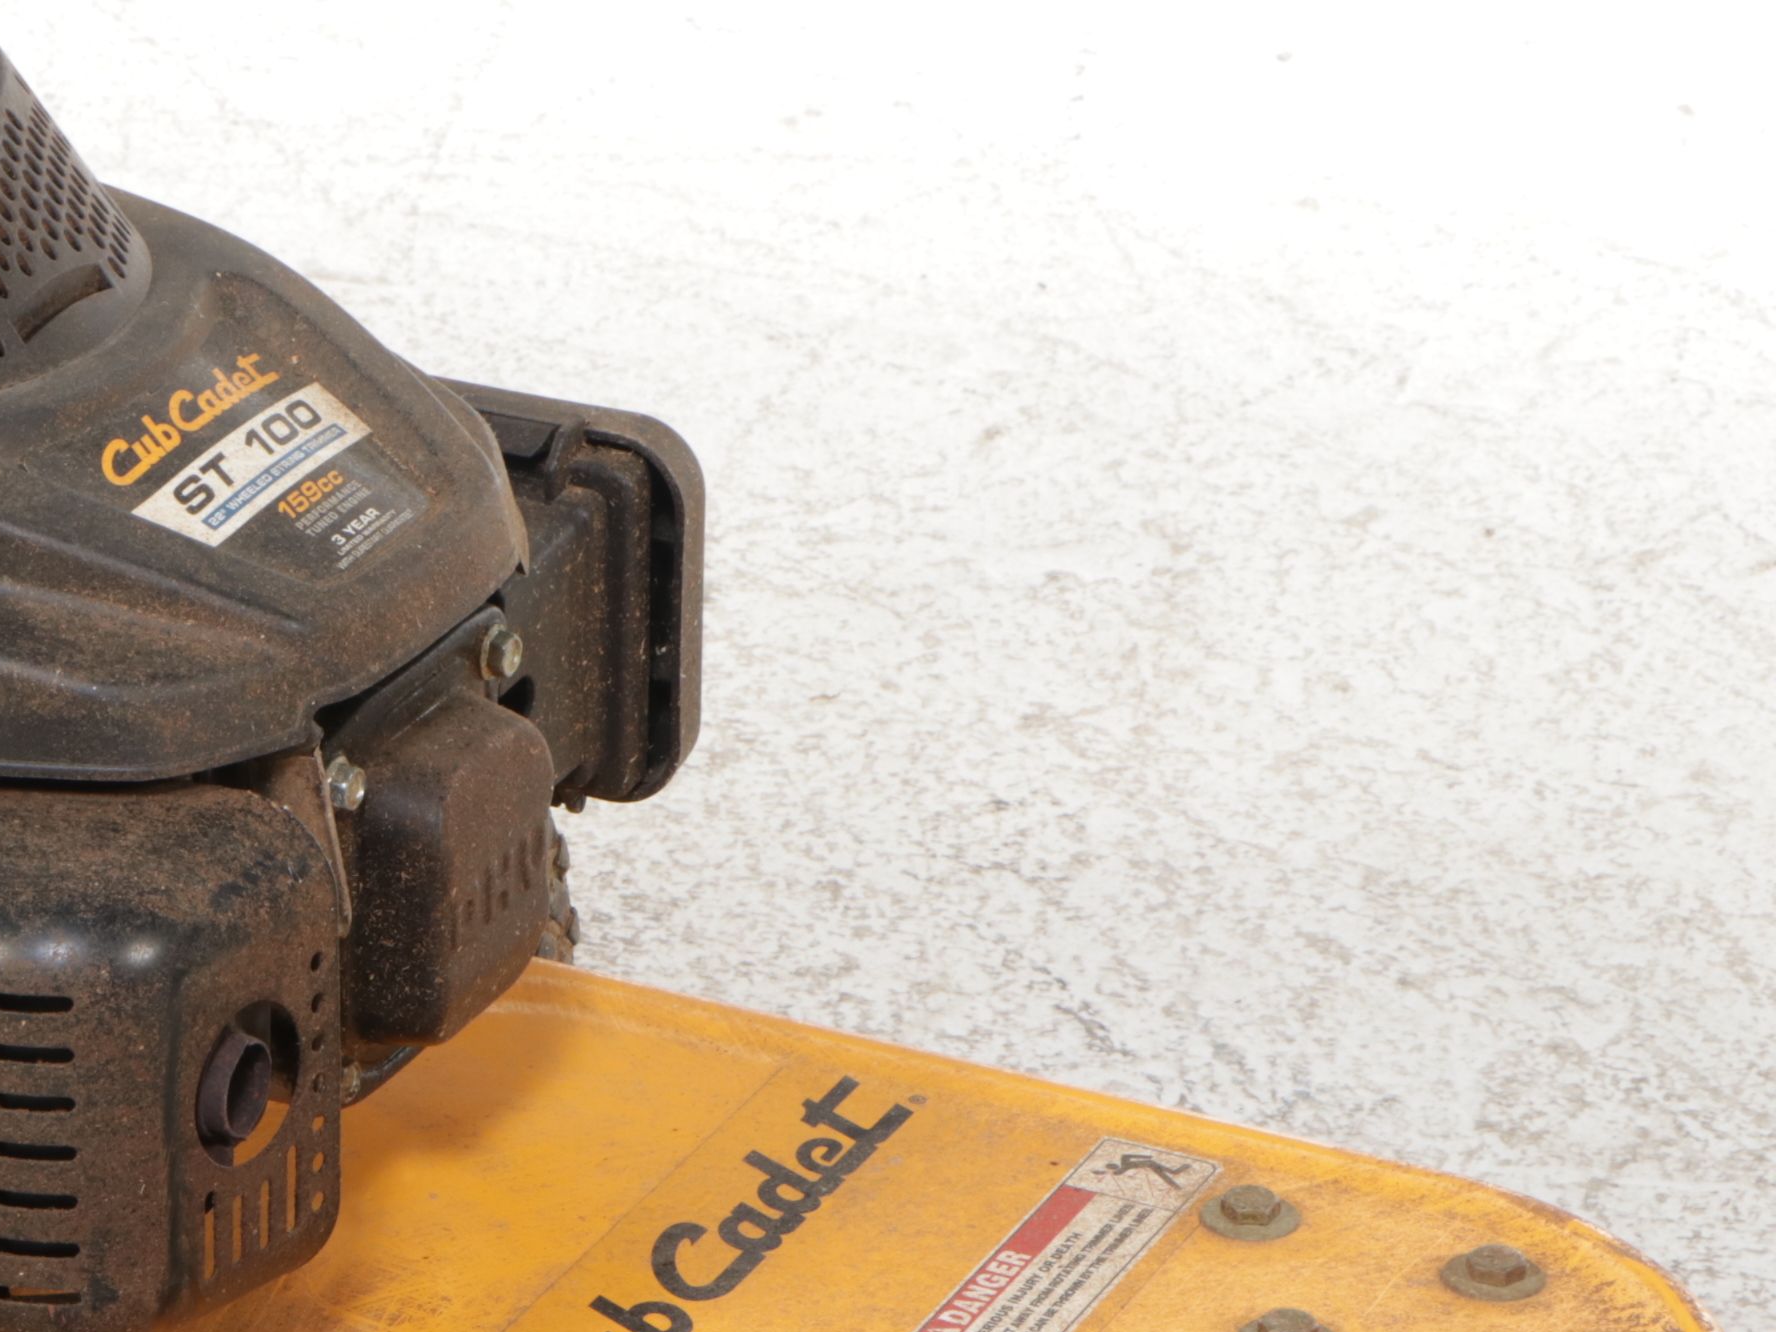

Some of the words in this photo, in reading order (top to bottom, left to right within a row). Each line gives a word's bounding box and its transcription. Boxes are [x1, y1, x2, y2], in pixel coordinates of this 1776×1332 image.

[101, 414, 182, 486] Cub
[168, 352, 281, 432] Cadet
[173, 452, 231, 515] ST
[244, 399, 322, 455] 100
[228, 473, 272, 513] WHEELED
[271, 451, 305, 479] STRING
[302, 425, 342, 457] TRIMMER
[277, 468, 345, 519] 159cc
[295, 479, 363, 530] PERFORMANCE
[304, 507, 339, 537] TUNED
[336, 487, 375, 518] ENGINE
[331, 528, 346, 546] 3
[340, 508, 381, 540] YEAR
[650, 1074, 914, 1302] Cadet
[946, 1249, 1032, 1327] DANGER
[1008, 1272, 1043, 1304] INJURY
[1039, 1259, 1055, 1272] OR
[1051, 1231, 1081, 1259] DEATH
[1011, 1307, 1035, 1328] AWAY
[1030, 1286, 1054, 1307] FROM
[1049, 1253, 1085, 1288] ROTATING
[1082, 1222, 1114, 1253] TRIMMER
[1030, 1317, 1049, 1332] CAN
[1044, 1307, 1058, 1318] BE
[1053, 1278, 1086, 1308] THROWN
[1080, 1268, 1095, 1279] BY
[1089, 1255, 1107, 1270] THE
[1102, 1226, 1134, 1256] TRIMMER
